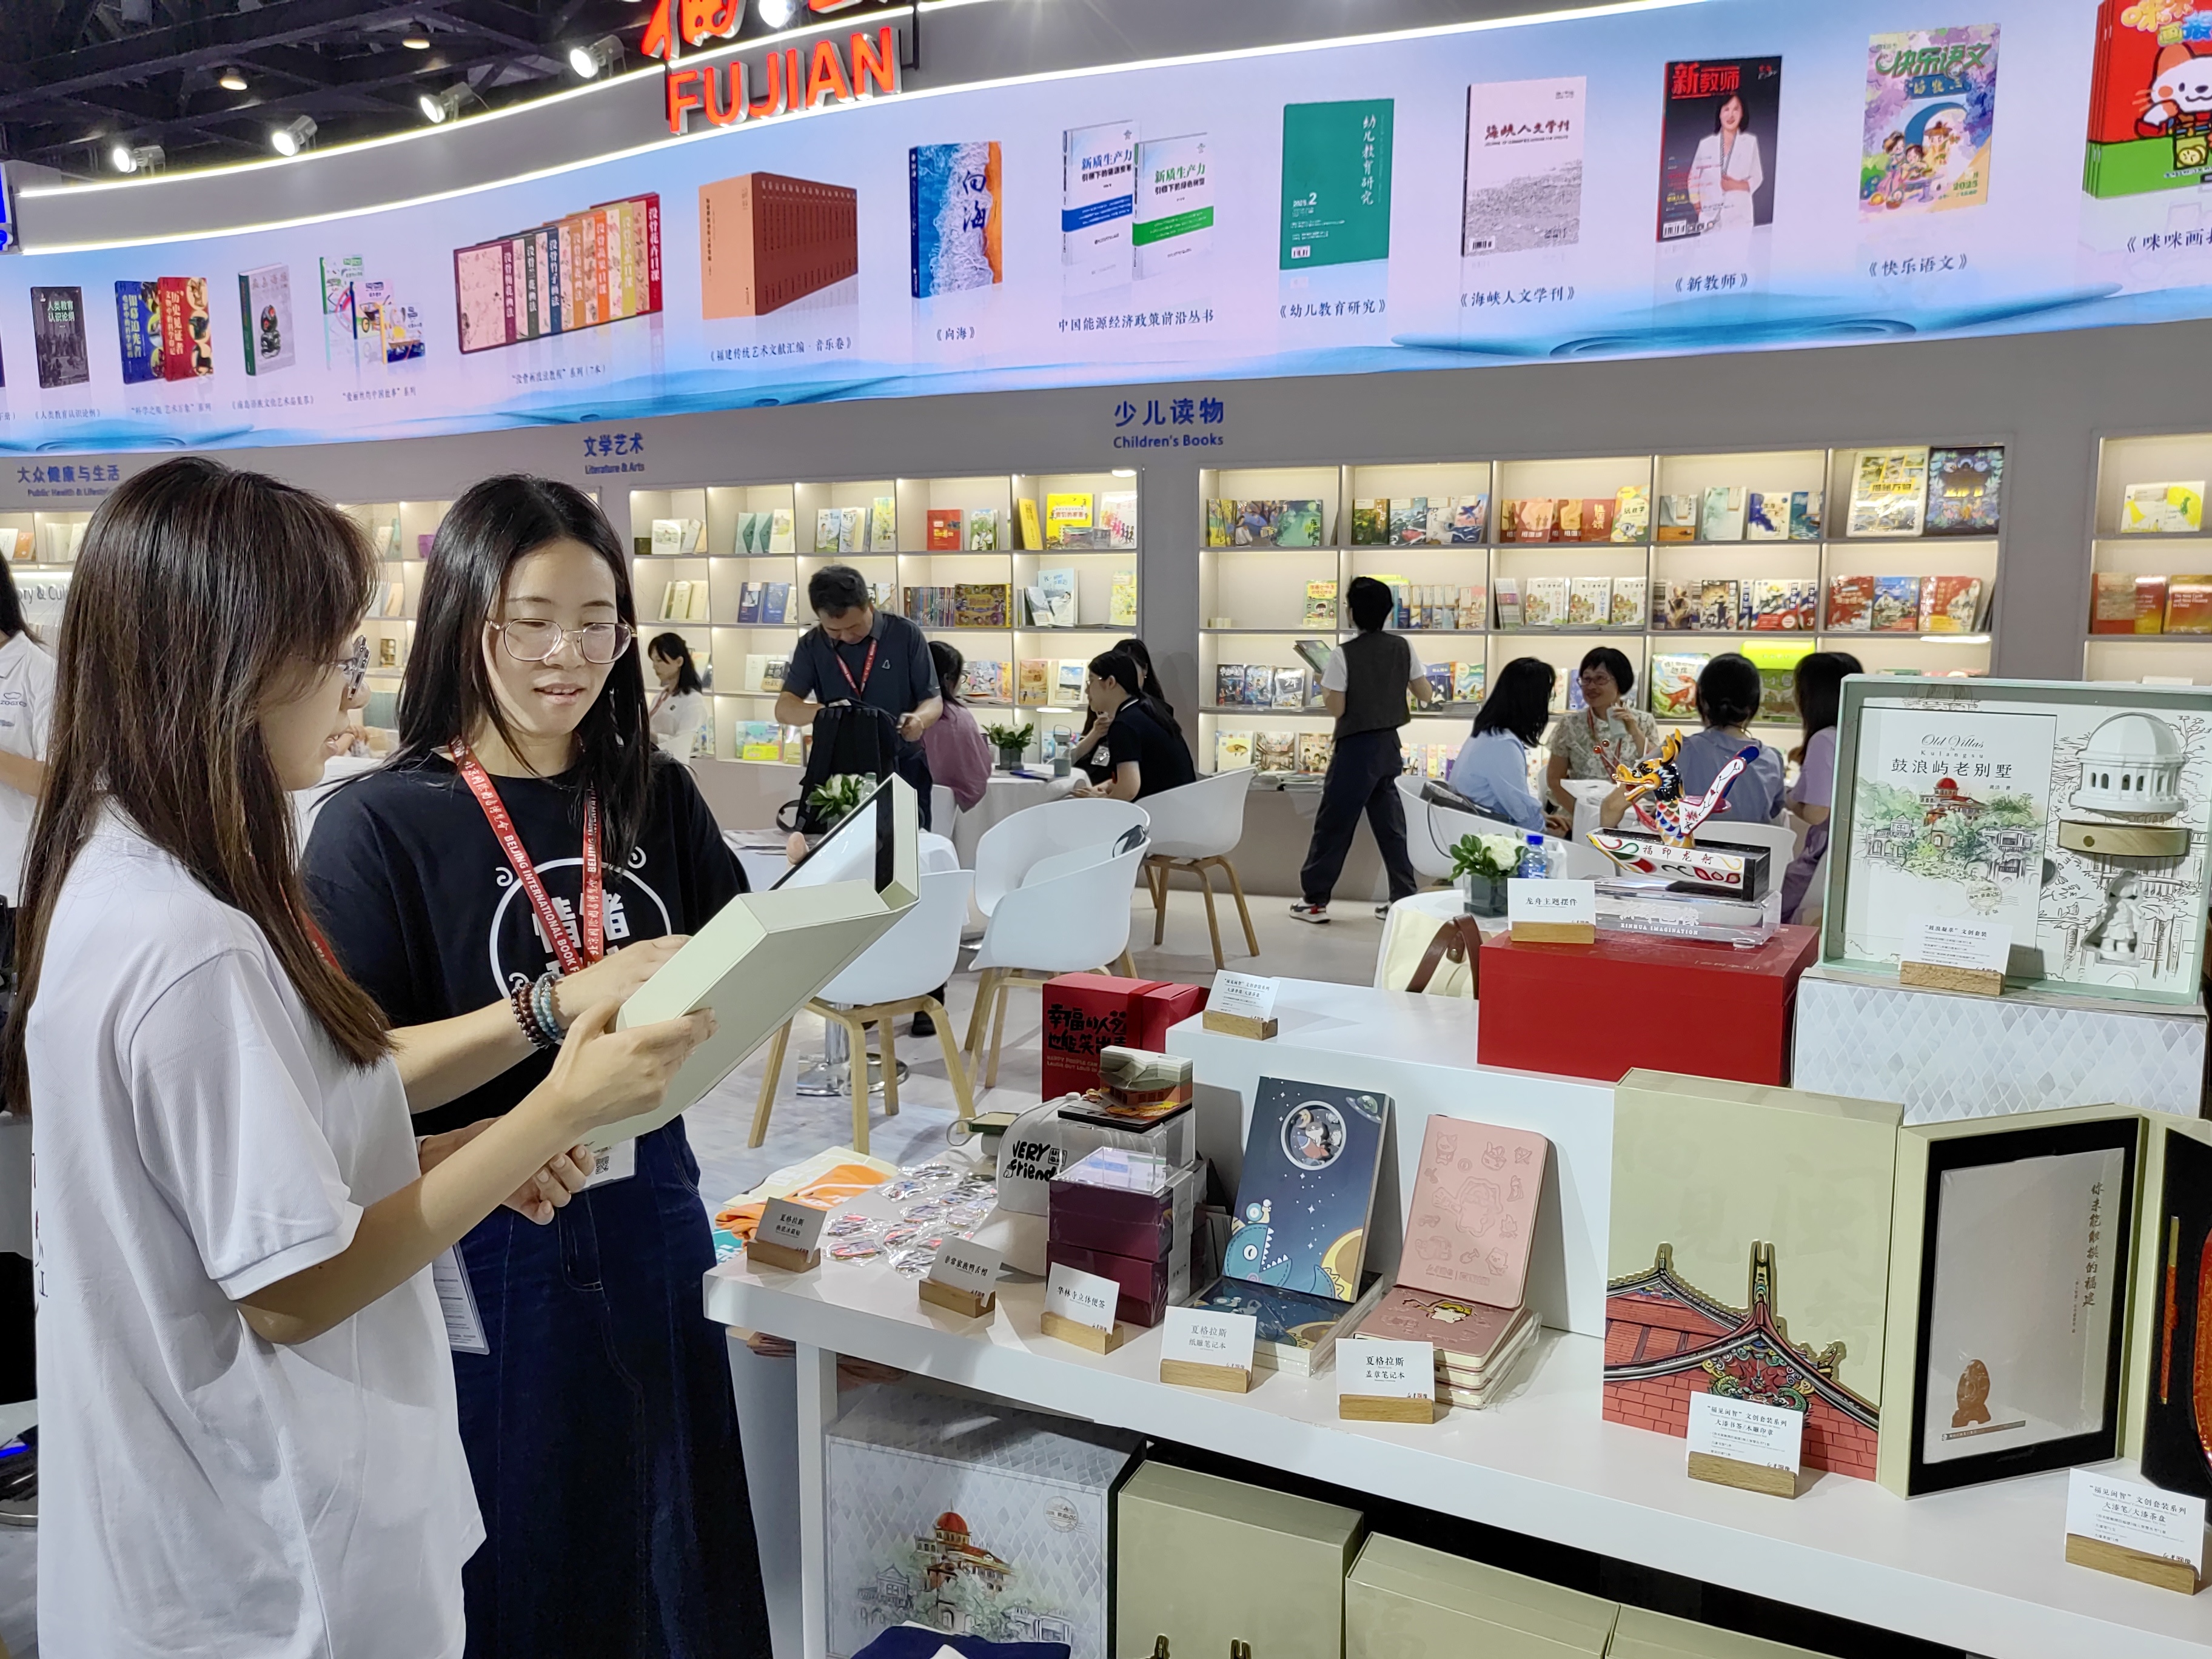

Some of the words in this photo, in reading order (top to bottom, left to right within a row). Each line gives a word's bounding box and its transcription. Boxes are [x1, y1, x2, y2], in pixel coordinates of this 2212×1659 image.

[1875, 42, 1992, 79] 快乐语文
[668, 26, 900, 134] FUJIAN
[1671, 62, 1741, 95] 新教师
[1485, 119, 1569, 140] 海峡人文学刊
[1082, 149, 1132, 171] 新质生产力
[1361, 113, 1376, 206] 幼儿教育研究
[1155, 163, 1205, 184] 新质生产力
[962, 170, 987, 233] 向海
[1869, 253, 1968, 278] 《快乐语文》
[1675, 273, 1748, 293] 《新教师》
[47, 300, 74, 312] 人类教育
[1460, 286, 1575, 307] 《海峡人文学刊》
[1279, 299, 1387, 319] 《幼儿教育研究》
[1058, 309, 1215, 333] 中国能源经济政策前沿丛书
[936, 326, 976, 341] 《向海》
[1114, 397, 1224, 427] 少儿读物
[583, 432, 644, 457] 文学艺术
[1114, 435, 1179, 448] Children's
[1183, 434, 1224, 446] Books
[17, 464, 121, 483] 大众健康与生活
[585, 464, 620, 474] Literature
[629, 461, 645, 472] Arts
[27, 488, 49, 497] Public
[37, 585, 46, 600] &
[1922, 734, 1946, 746] Old
[1948, 735, 1984, 748] Villas
[1891, 758, 2012, 779] 鼓浪屿老别墅
[587, 838, 597, 873] BEIJING
[504, 835, 528, 869] BEIJING
[522, 870, 563, 939] INTERNATIONAL
[557, 939, 577, 968] BOOK
[1525, 897, 1578, 907] 龙舟主题摆件
[1650, 925, 1698, 935] IMAGINATION
[1013, 1140, 1051, 1162] VERY
[1057, 1286, 1105, 1309] 华林寺立体便签
[1191, 1325, 1227, 1338] 夏格拉斯
[1188, 1338, 1226, 1350] 纸雕笔记本
[1366, 1356, 1404, 1367] 夏格拉斯
[1366, 1370, 1405, 1379] 盖章笔记本
[1746, 1413, 1787, 1427] 文创套装系列
[2136, 1496, 2187, 1515] 文创套装系列
